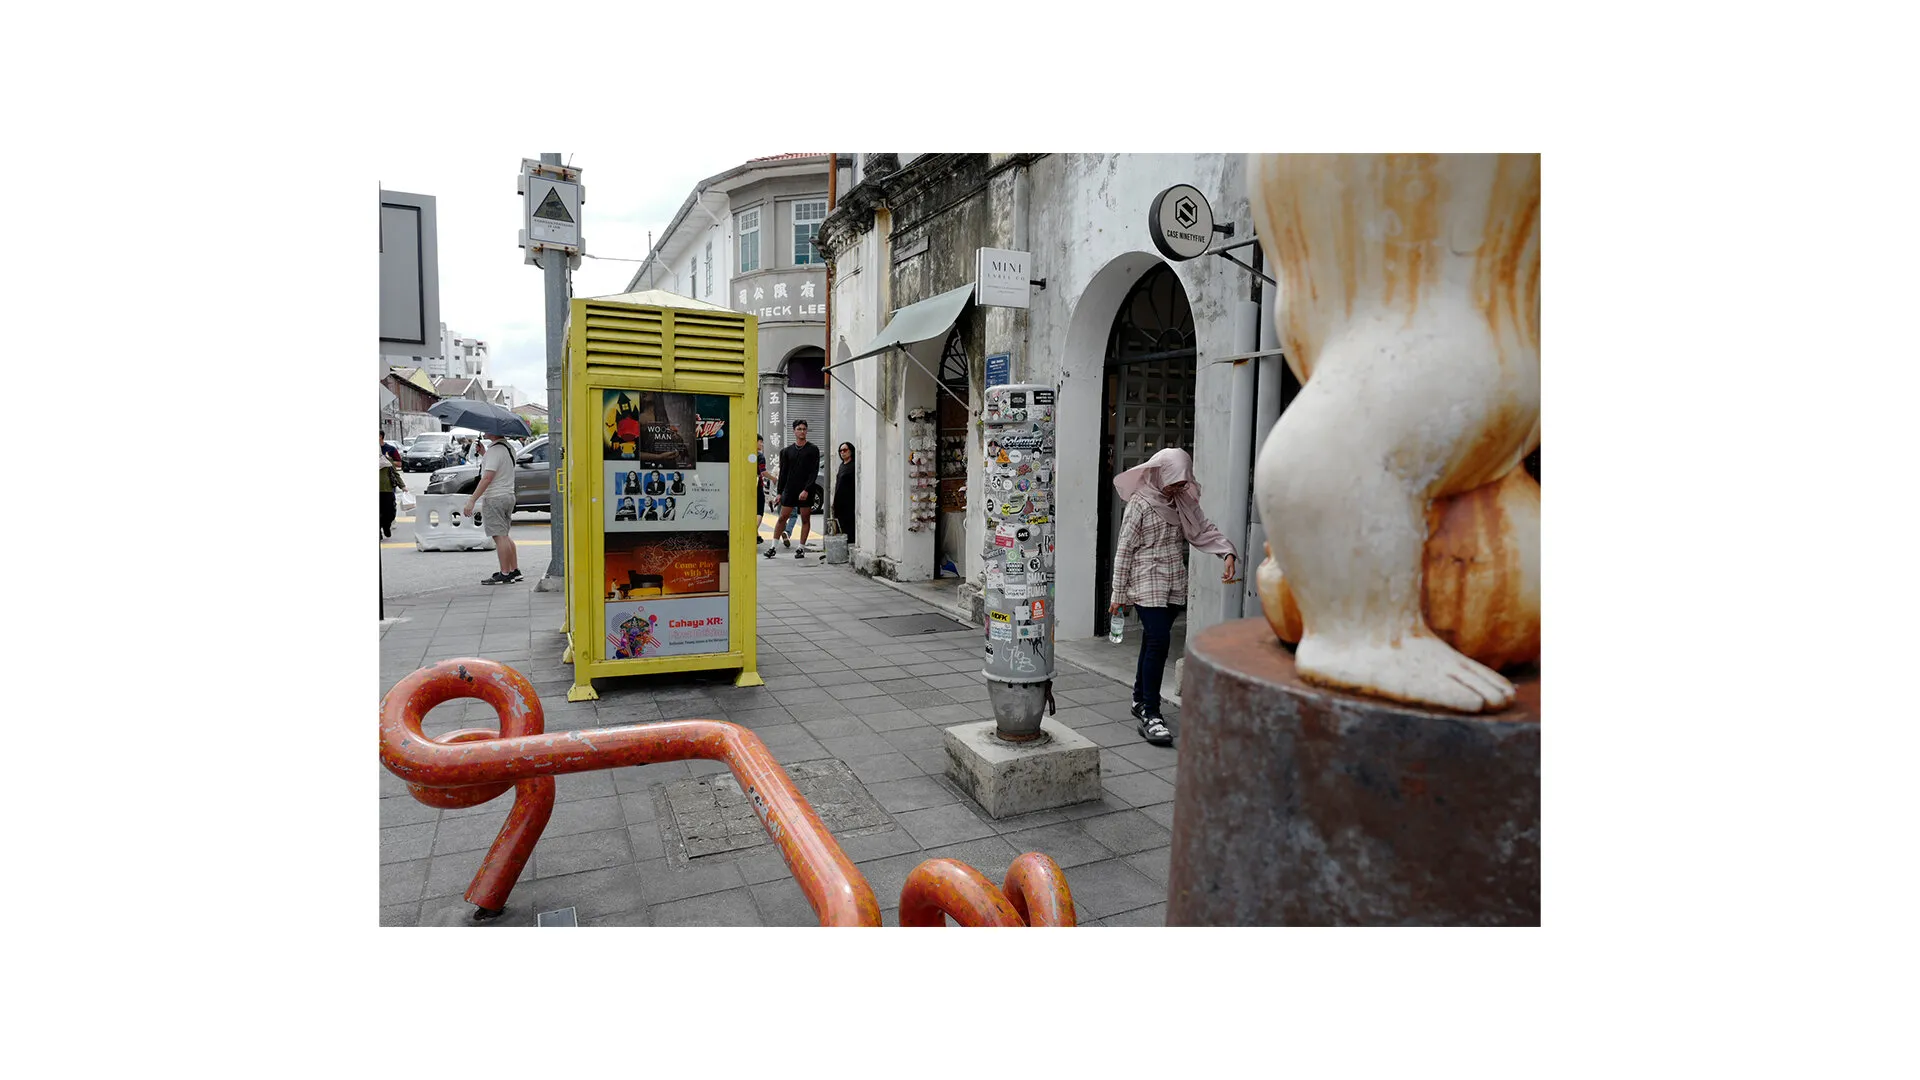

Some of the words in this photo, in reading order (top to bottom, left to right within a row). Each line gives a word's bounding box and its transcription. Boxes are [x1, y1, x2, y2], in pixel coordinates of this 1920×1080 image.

[1167, 229, 1179, 239] CASE
[1179, 232, 1205, 243] NINETYFIVE
[992, 260, 1022, 273] MINI
[759, 305, 792, 317] TECK
[799, 303, 827, 315] LEE
[684, 569, 702, 577] with
[669, 619, 704, 628] Cahaya
[706, 617, 723, 625] XR:
